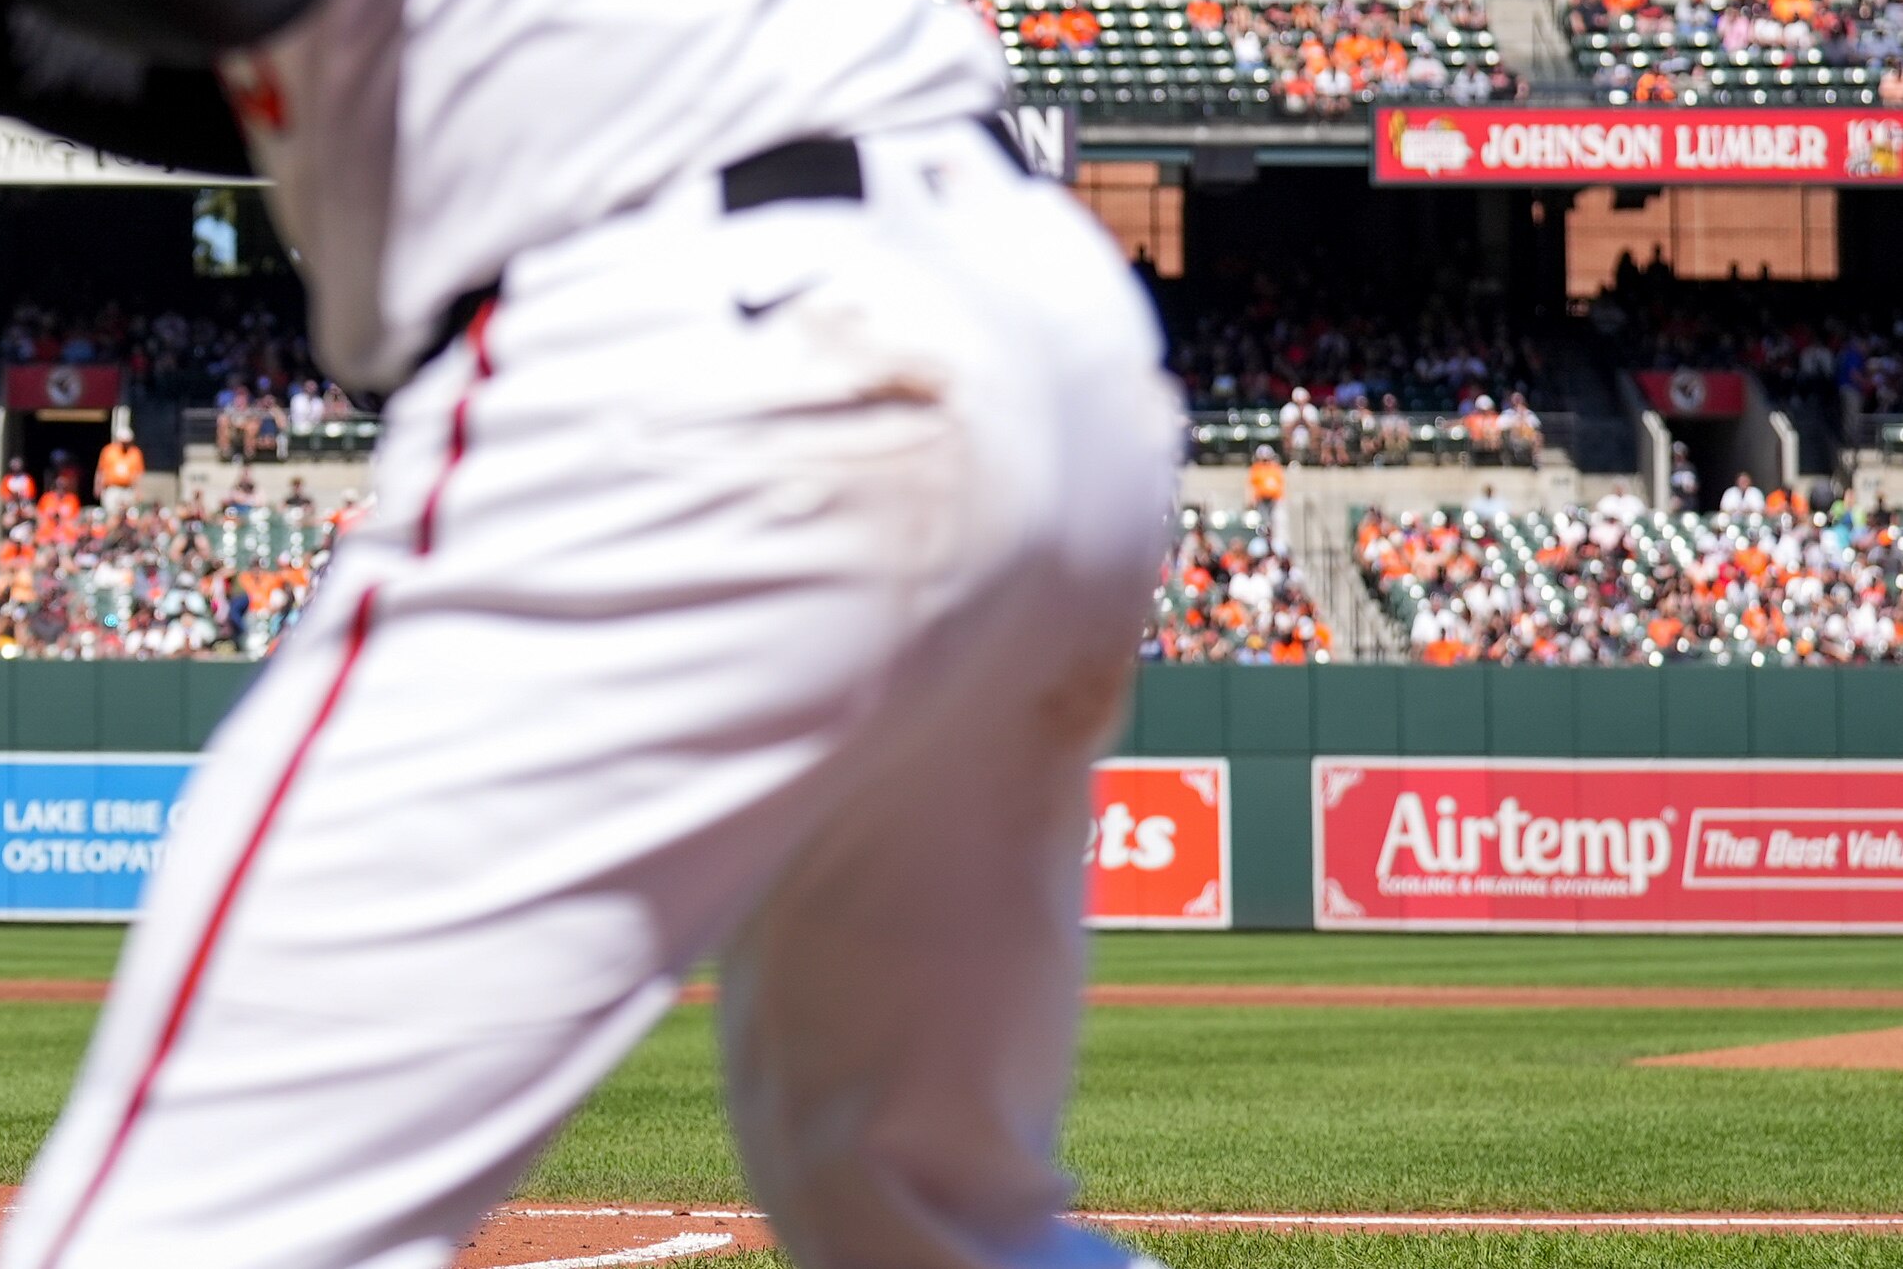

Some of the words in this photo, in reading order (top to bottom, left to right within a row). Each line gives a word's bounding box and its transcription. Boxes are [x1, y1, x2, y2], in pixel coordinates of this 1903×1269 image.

[1480, 123, 1662, 169] JOHNSON
[1674, 124, 1827, 169] LUMBER
[3, 799, 87, 833] LAKE
[92, 799, 163, 834] ERIE
[1704, 828, 1762, 869] The
[1764, 828, 1843, 869] Best
